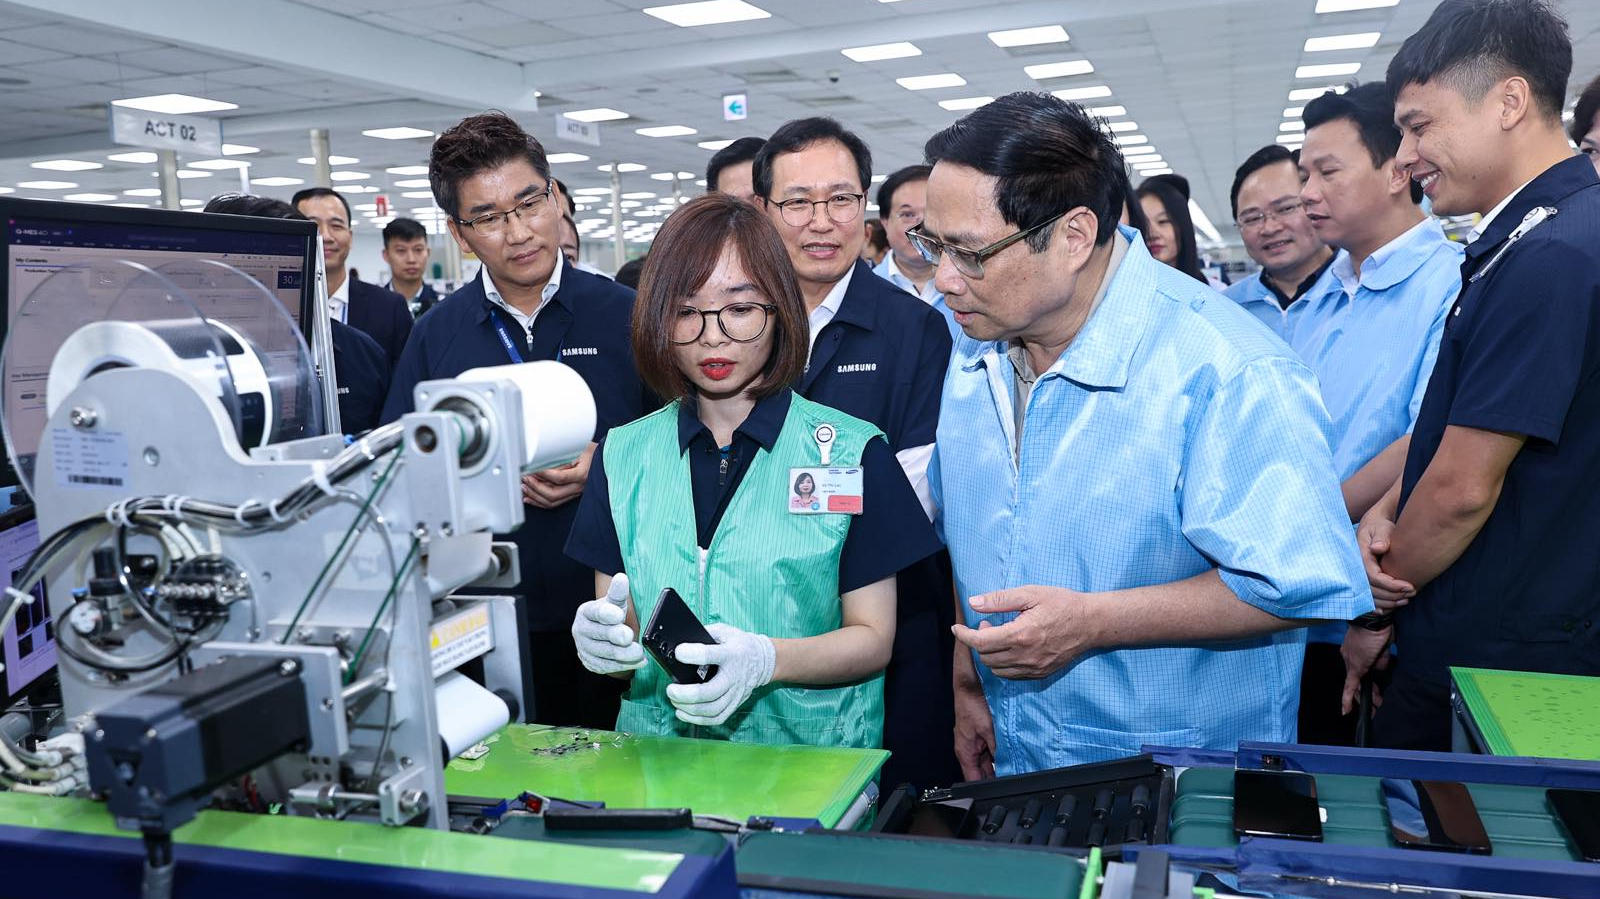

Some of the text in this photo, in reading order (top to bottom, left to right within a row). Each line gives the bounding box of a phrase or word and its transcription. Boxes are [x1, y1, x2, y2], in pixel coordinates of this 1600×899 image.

[145, 121, 197, 141] ACT 02
[282, 276, 293, 284] 30
[562, 347, 598, 356] SAMSUNG
[837, 363, 877, 372] SAMSUNG
